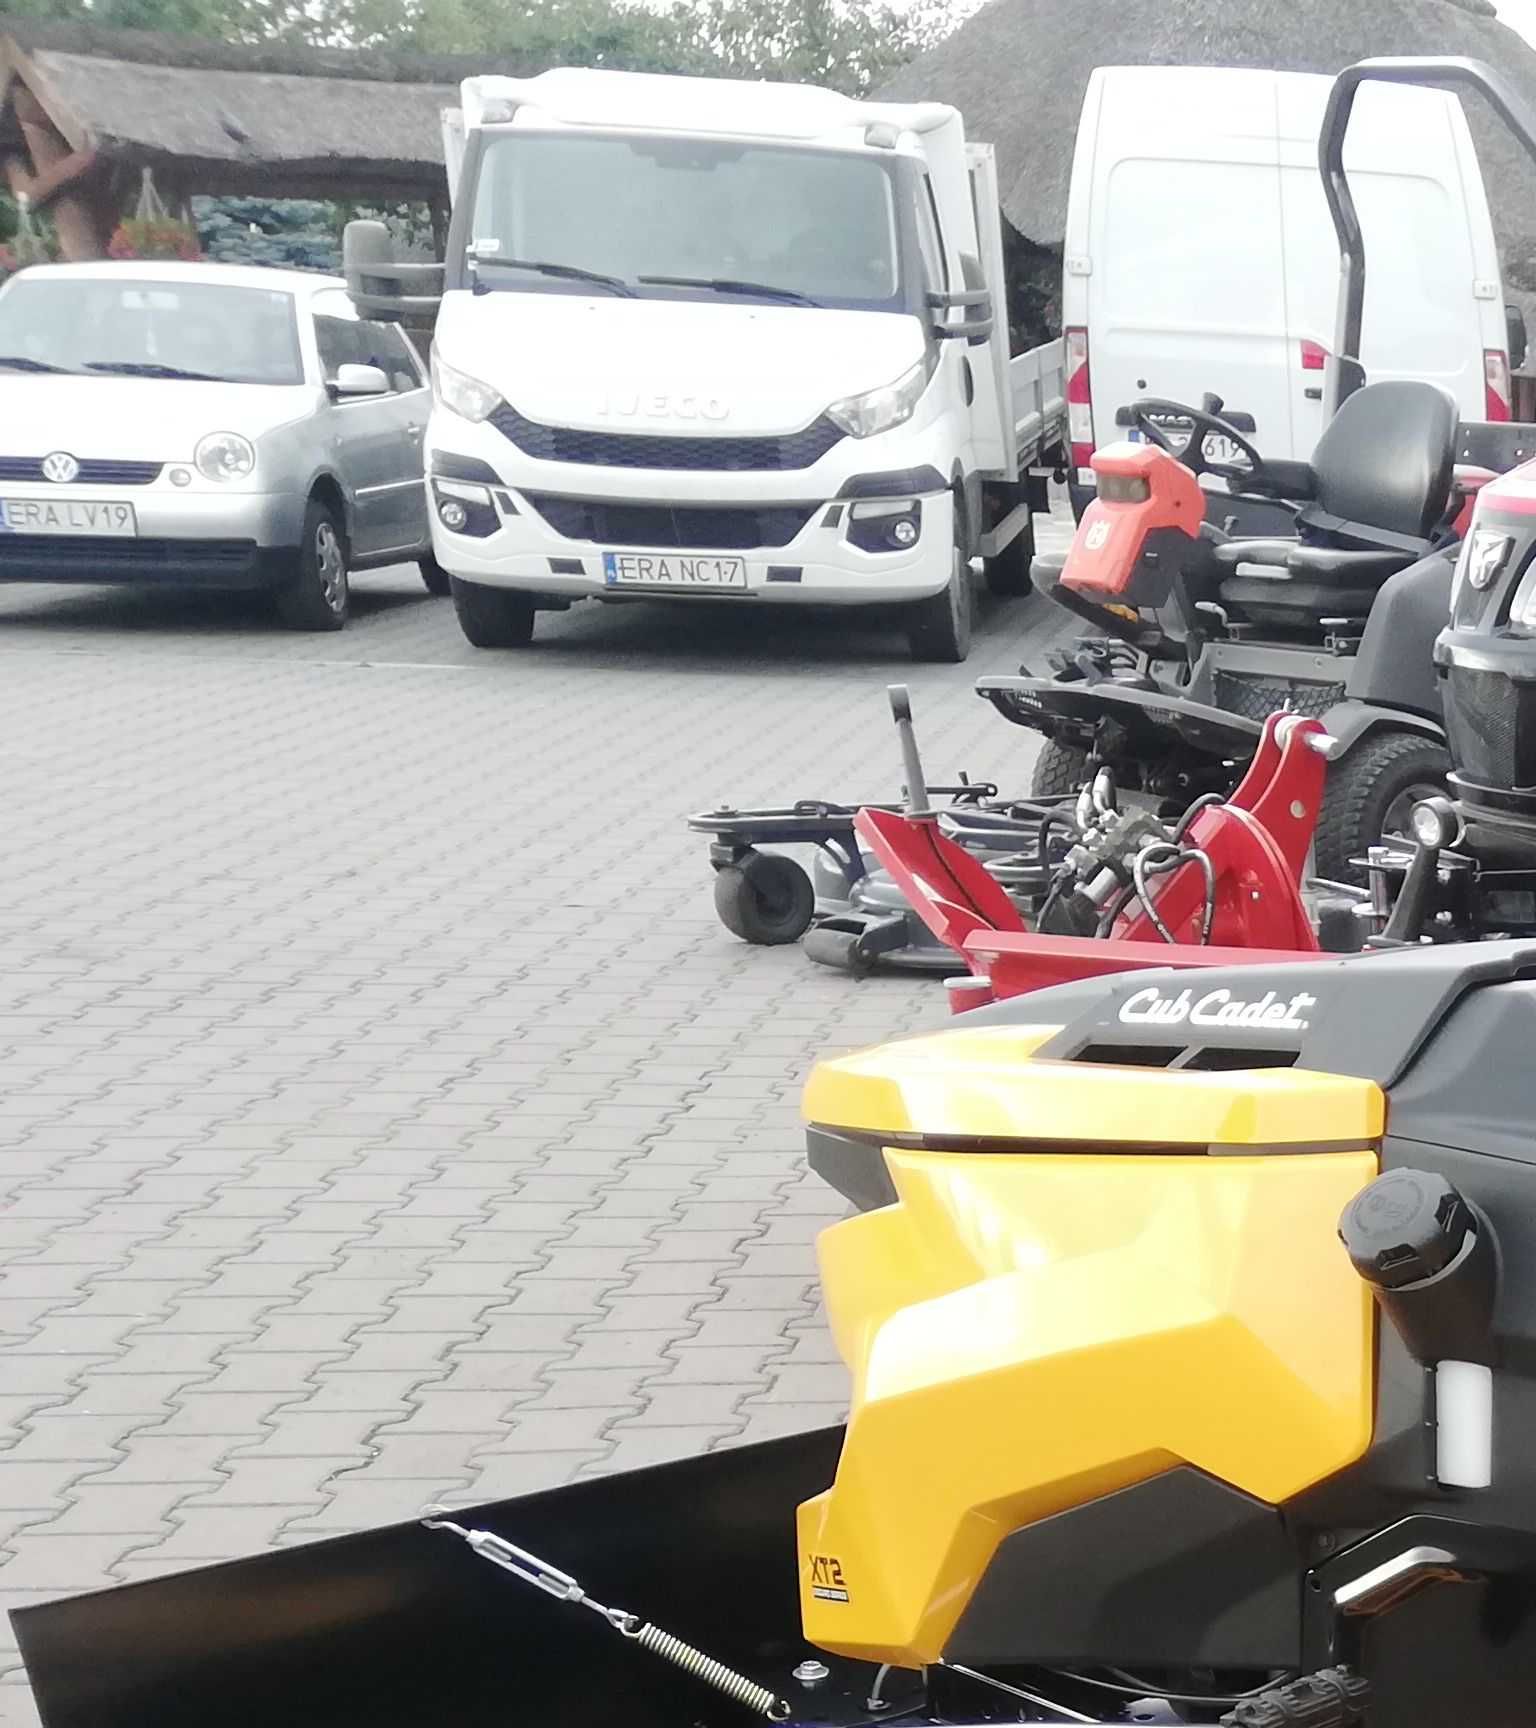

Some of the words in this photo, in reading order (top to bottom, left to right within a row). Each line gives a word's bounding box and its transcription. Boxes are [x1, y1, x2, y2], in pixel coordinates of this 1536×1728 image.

[597, 391, 731, 420] IVECO
[7, 502, 60, 528] ERA
[66, 504, 128, 529] LV19
[619, 557, 673, 581] ERA
[1119, 987, 1193, 1024] Cub
[808, 1553, 847, 1586] XT2
